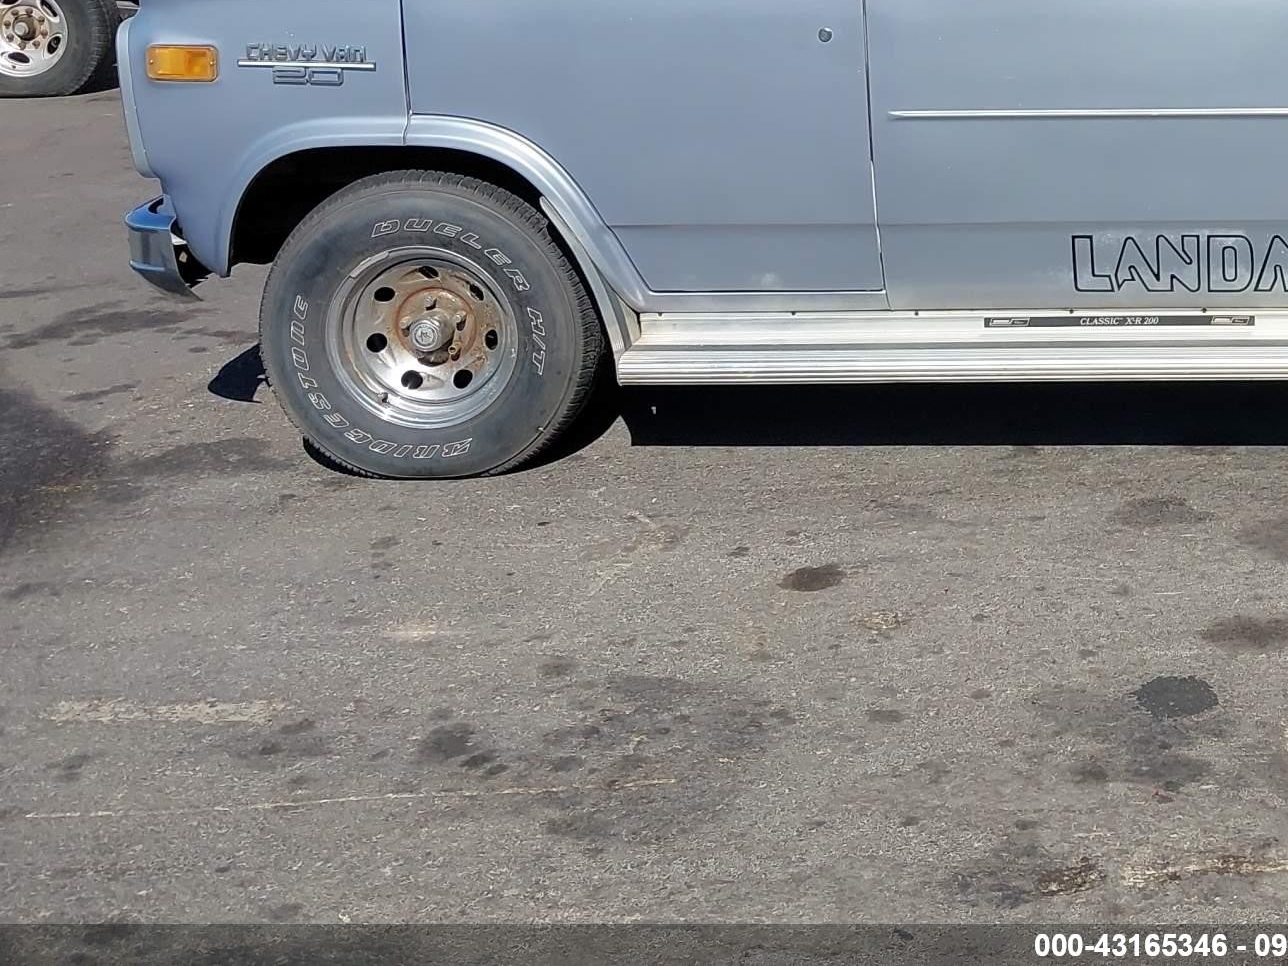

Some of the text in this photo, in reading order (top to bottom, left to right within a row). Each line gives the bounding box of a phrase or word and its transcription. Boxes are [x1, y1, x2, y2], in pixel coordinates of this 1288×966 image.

[246, 43, 368, 63] CHEVY VAN
[271, 66, 345, 87] 20
[371, 218, 546, 376] DUELER H/T
[1143, 315, 1159, 325] 200
[290, 294, 473, 459] BRIDGESTONE
